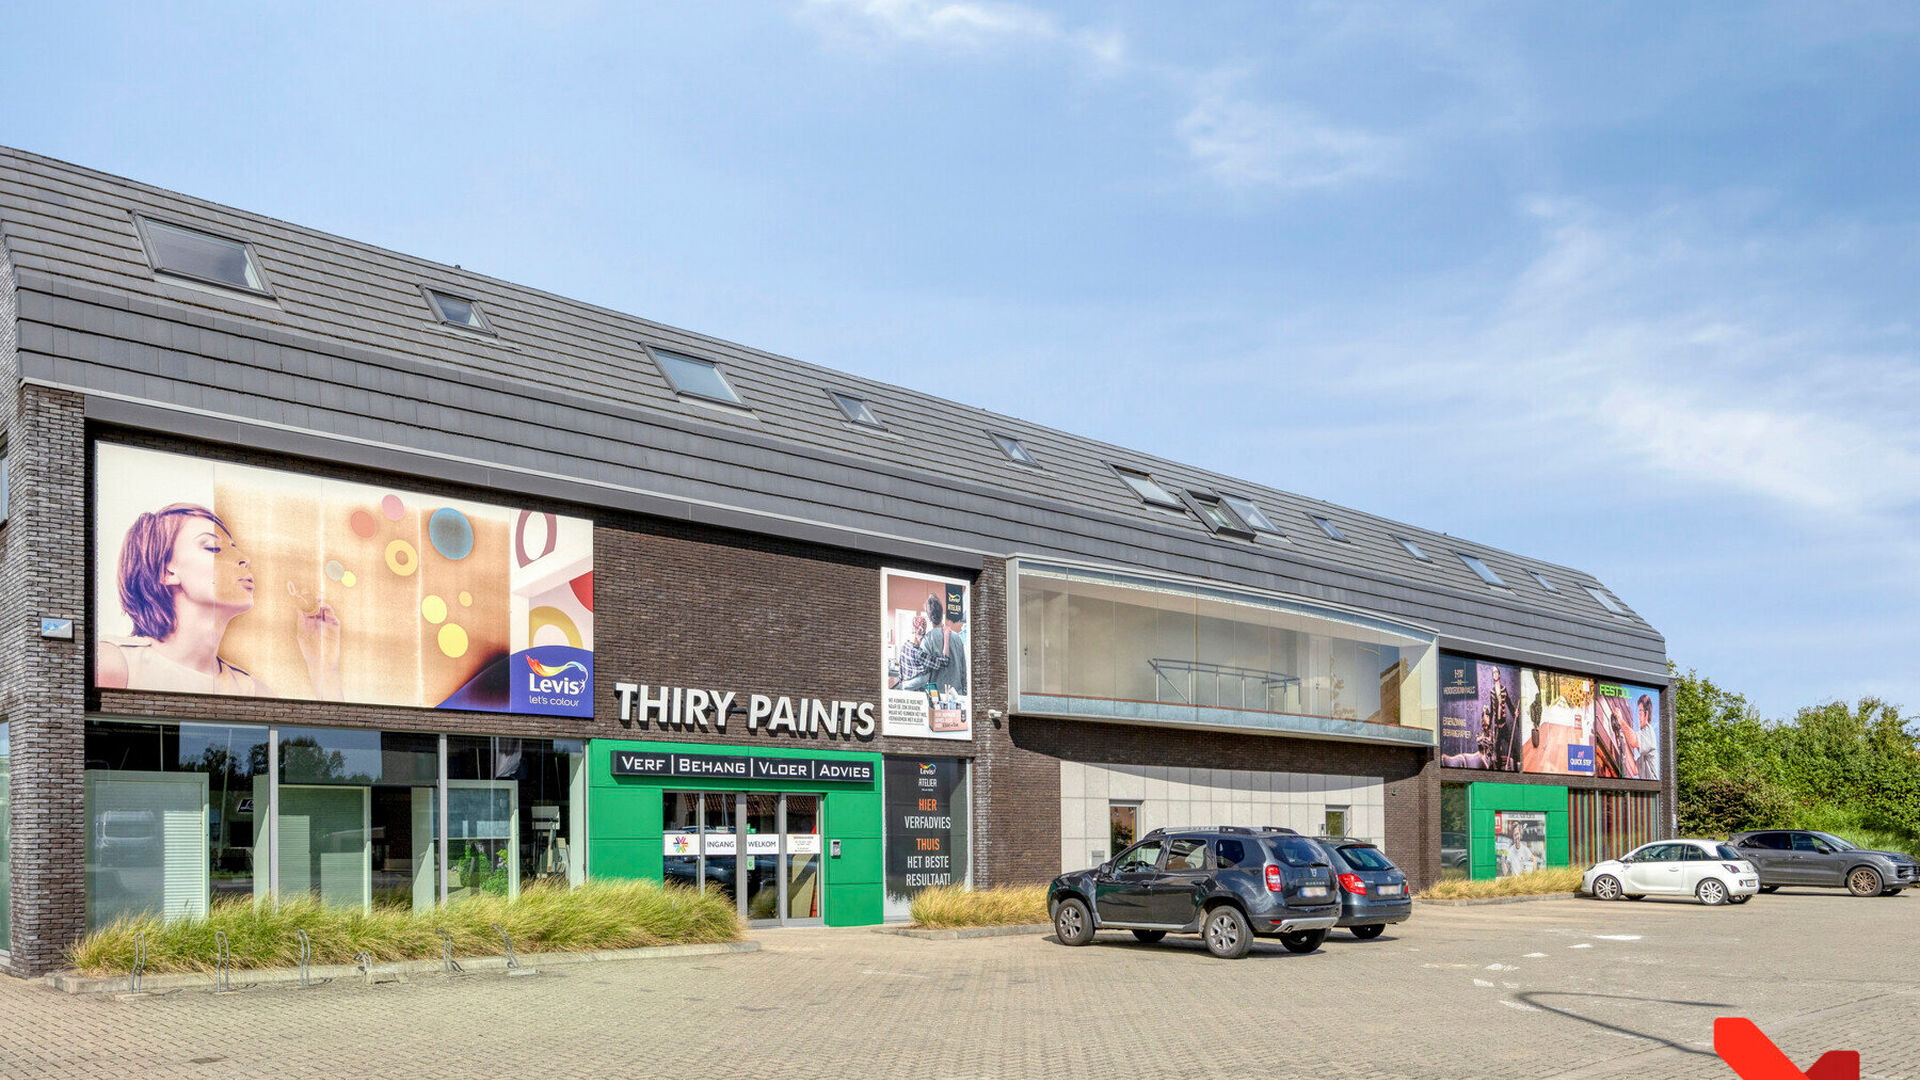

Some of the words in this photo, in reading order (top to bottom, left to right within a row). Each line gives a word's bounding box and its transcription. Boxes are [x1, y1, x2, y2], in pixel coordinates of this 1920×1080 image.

[529, 673, 579, 695] Levis
[529, 695, 548, 705] let's
[550, 697, 580, 707] colour
[615, 683, 736, 726] THIRY
[749, 694, 875, 736] PAINTS
[622, 756, 666, 771] VERF
[679, 758, 746, 774] BEHANG
[758, 761, 807, 777] VLOER
[819, 763, 870, 778] ADVIES
[918, 778, 937, 787] ATELIER
[918, 798, 937, 811] HIER
[904, 816, 951, 829] VERFADVIES
[706, 840, 735, 848] INGANG
[916, 838, 940, 851] THUIS
[907, 855, 923, 868] HET
[925, 856, 949, 869] BESTE
[906, 873, 951, 886] RESULTAAT!
